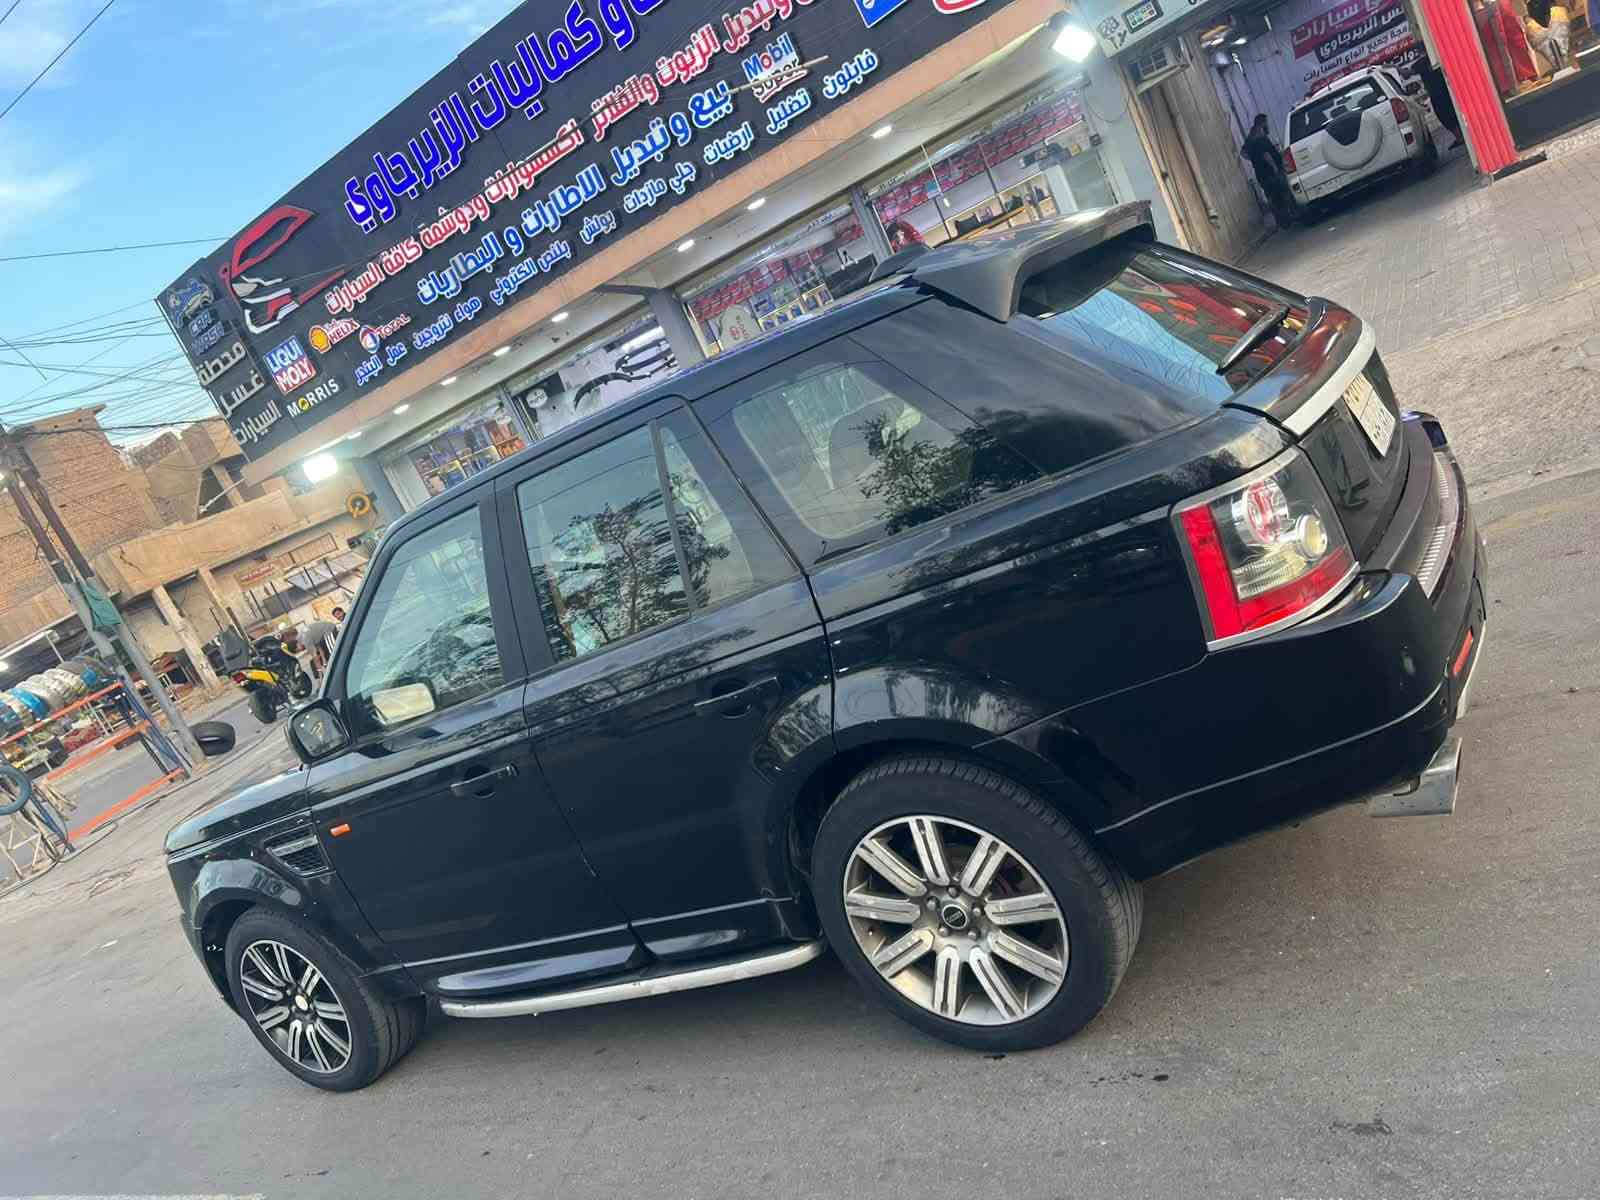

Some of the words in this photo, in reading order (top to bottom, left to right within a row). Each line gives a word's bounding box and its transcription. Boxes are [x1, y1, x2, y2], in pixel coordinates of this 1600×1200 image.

[468, 0, 603, 131] كماليات
[656, 24, 721, 87] الزيوت
[742, 32, 796, 81] Mobil
[822, 48, 879, 99] فابلون
[592, 73, 660, 142] والفلاتر
[688, 80, 734, 129] بيع
[766, 87, 812, 135] تضليل
[611, 117, 671, 186] تبديل
[669, 112, 692, 147] و
[704, 121, 755, 165] ارضيات
[344, 93, 478, 233] الزيرجاوي
[484, 118, 584, 203] اكسسوارات
[669, 161, 697, 195] جلي
[521, 163, 607, 238] الاطارات
[503, 225, 525, 257] و
[579, 209, 617, 244] بولش
[324, 261, 385, 315] السيارات
[417, 231, 505, 305] البطاريات
[489, 257, 538, 305] الكتروني
[328, 320, 360, 344] HELIX
[454, 296, 483, 322] هواء
[195, 341, 247, 386] محطة
[265, 338, 304, 372] LIQUI
[275, 357, 313, 391] MOLY
[219, 369, 265, 418] غسل
[286, 377, 340, 418] MORRIS
